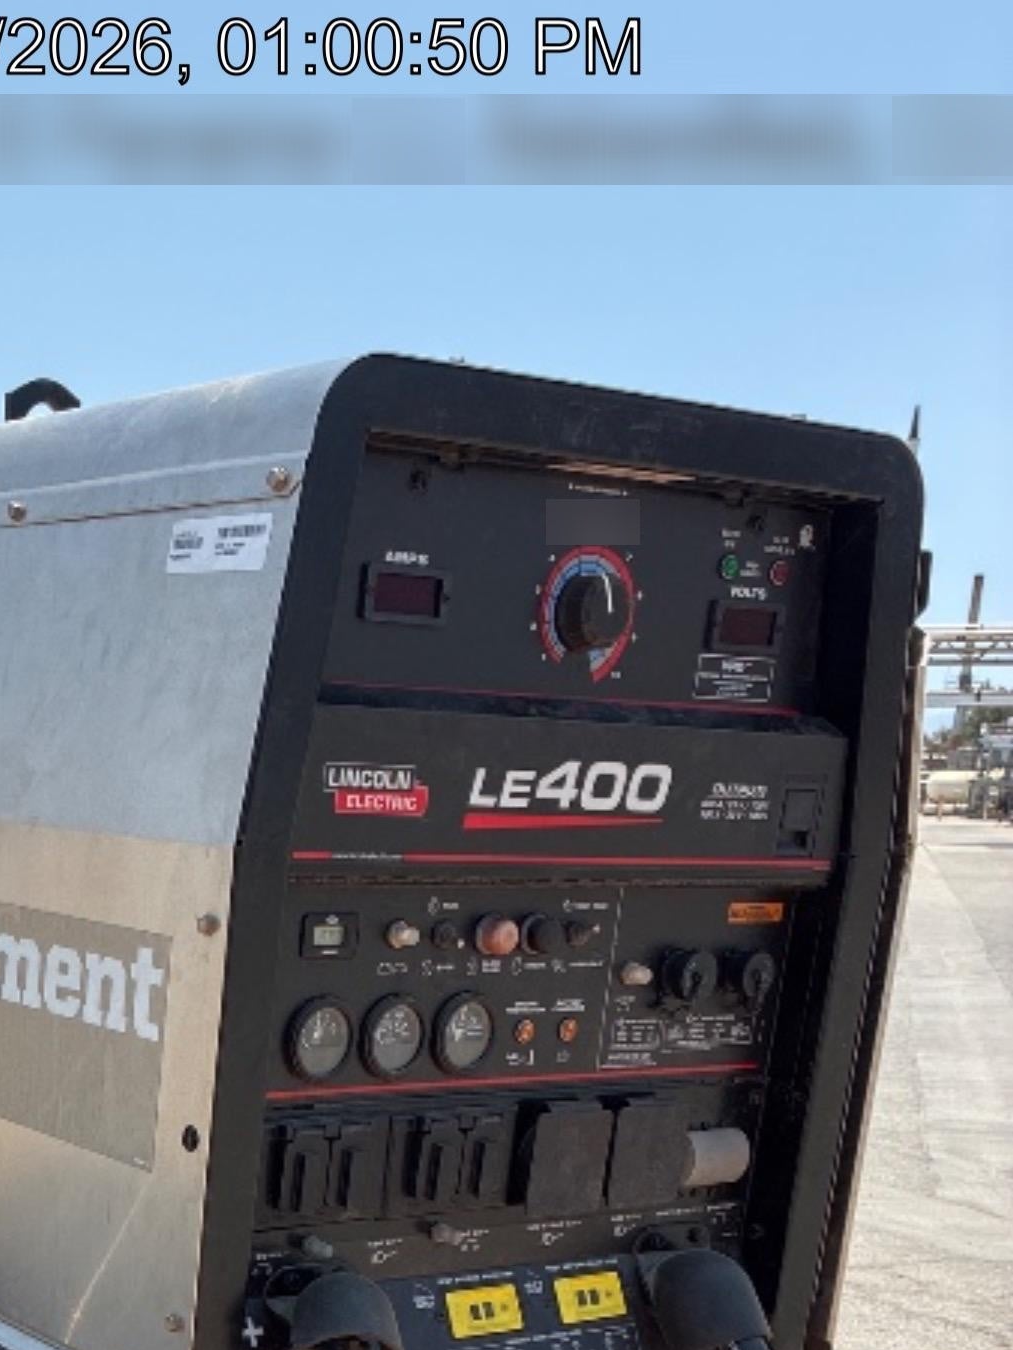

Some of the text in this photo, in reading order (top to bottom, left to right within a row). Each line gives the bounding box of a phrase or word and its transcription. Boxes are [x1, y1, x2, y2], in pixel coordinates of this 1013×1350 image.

[327, 767, 412, 790] LINCOLN
[468, 760, 673, 813] LE400
[346, 794, 418, 812] ELECTRIC
